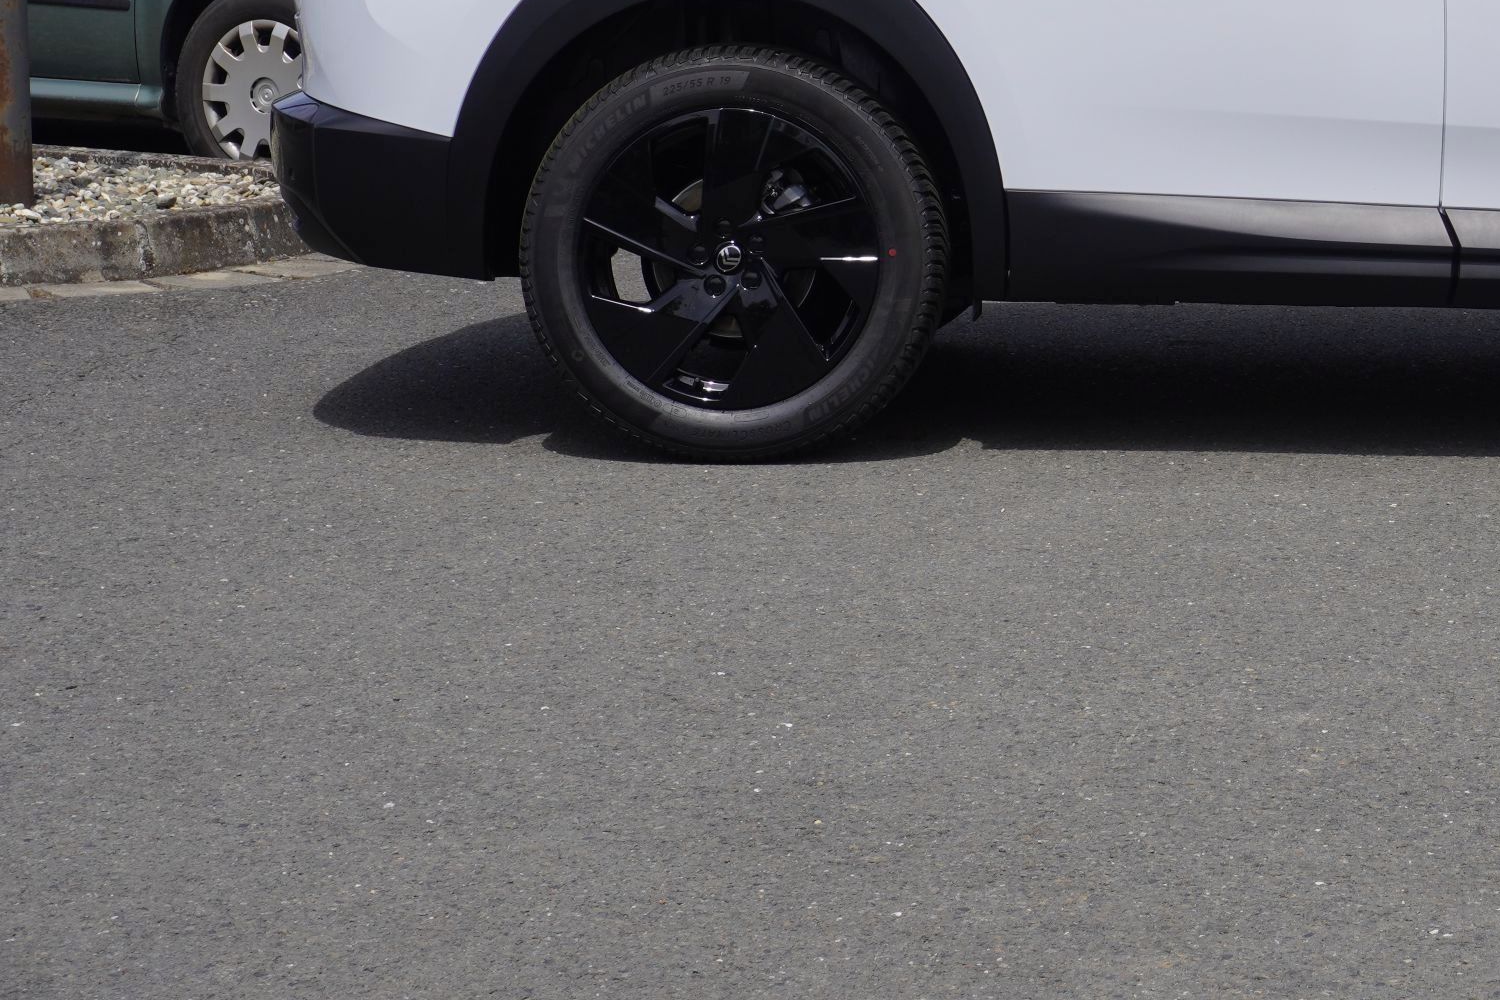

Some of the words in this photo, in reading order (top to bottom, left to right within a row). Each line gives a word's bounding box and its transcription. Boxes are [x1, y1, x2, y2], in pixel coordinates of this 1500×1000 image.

[660, 77, 702, 96] 225/55
[706, 75, 715, 85] R
[718, 75, 730, 84] 19
[565, 90, 650, 174] MICHELIN
